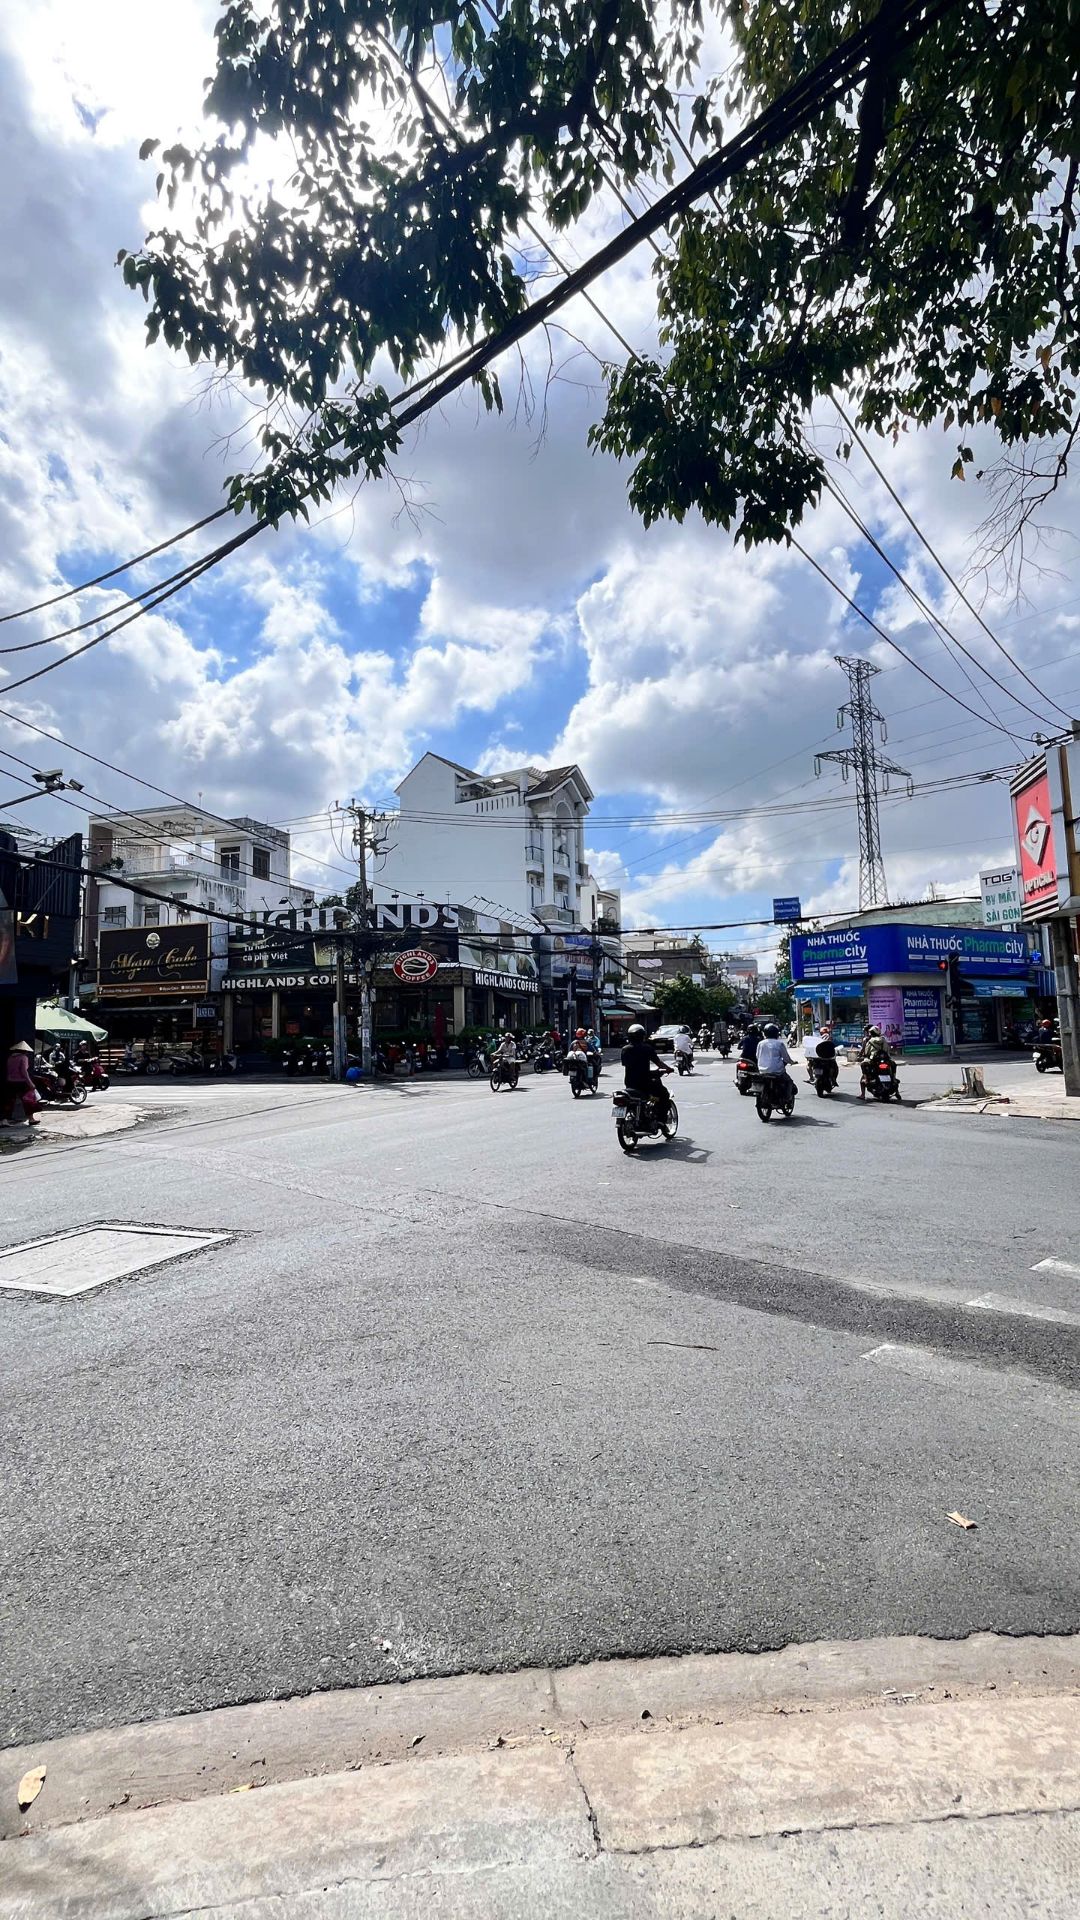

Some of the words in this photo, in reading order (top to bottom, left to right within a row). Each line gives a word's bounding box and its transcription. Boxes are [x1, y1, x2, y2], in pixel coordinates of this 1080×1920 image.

[982, 873, 1013, 885] TOG
[985, 895, 996, 905] BV
[228, 905, 459, 935] HIGHLNDS
[807, 935, 827, 946] NHÀ
[828, 930, 860, 944] THUỐC
[803, 943, 867, 960] Pharmacity
[907, 935, 929, 949] NHÀ
[930, 935, 963, 951] THUỐC
[964, 937, 1024, 958] Pharmacity
[271, 951, 288, 962] Việt
[396, 951, 435, 966] HIGHLANDS
[221, 976, 305, 990] HIGHLANDS
[400, 972, 431, 982] COFFEE
[475, 972, 517, 990] HIGHLANDS
[517, 979, 539, 993] COFFEE
